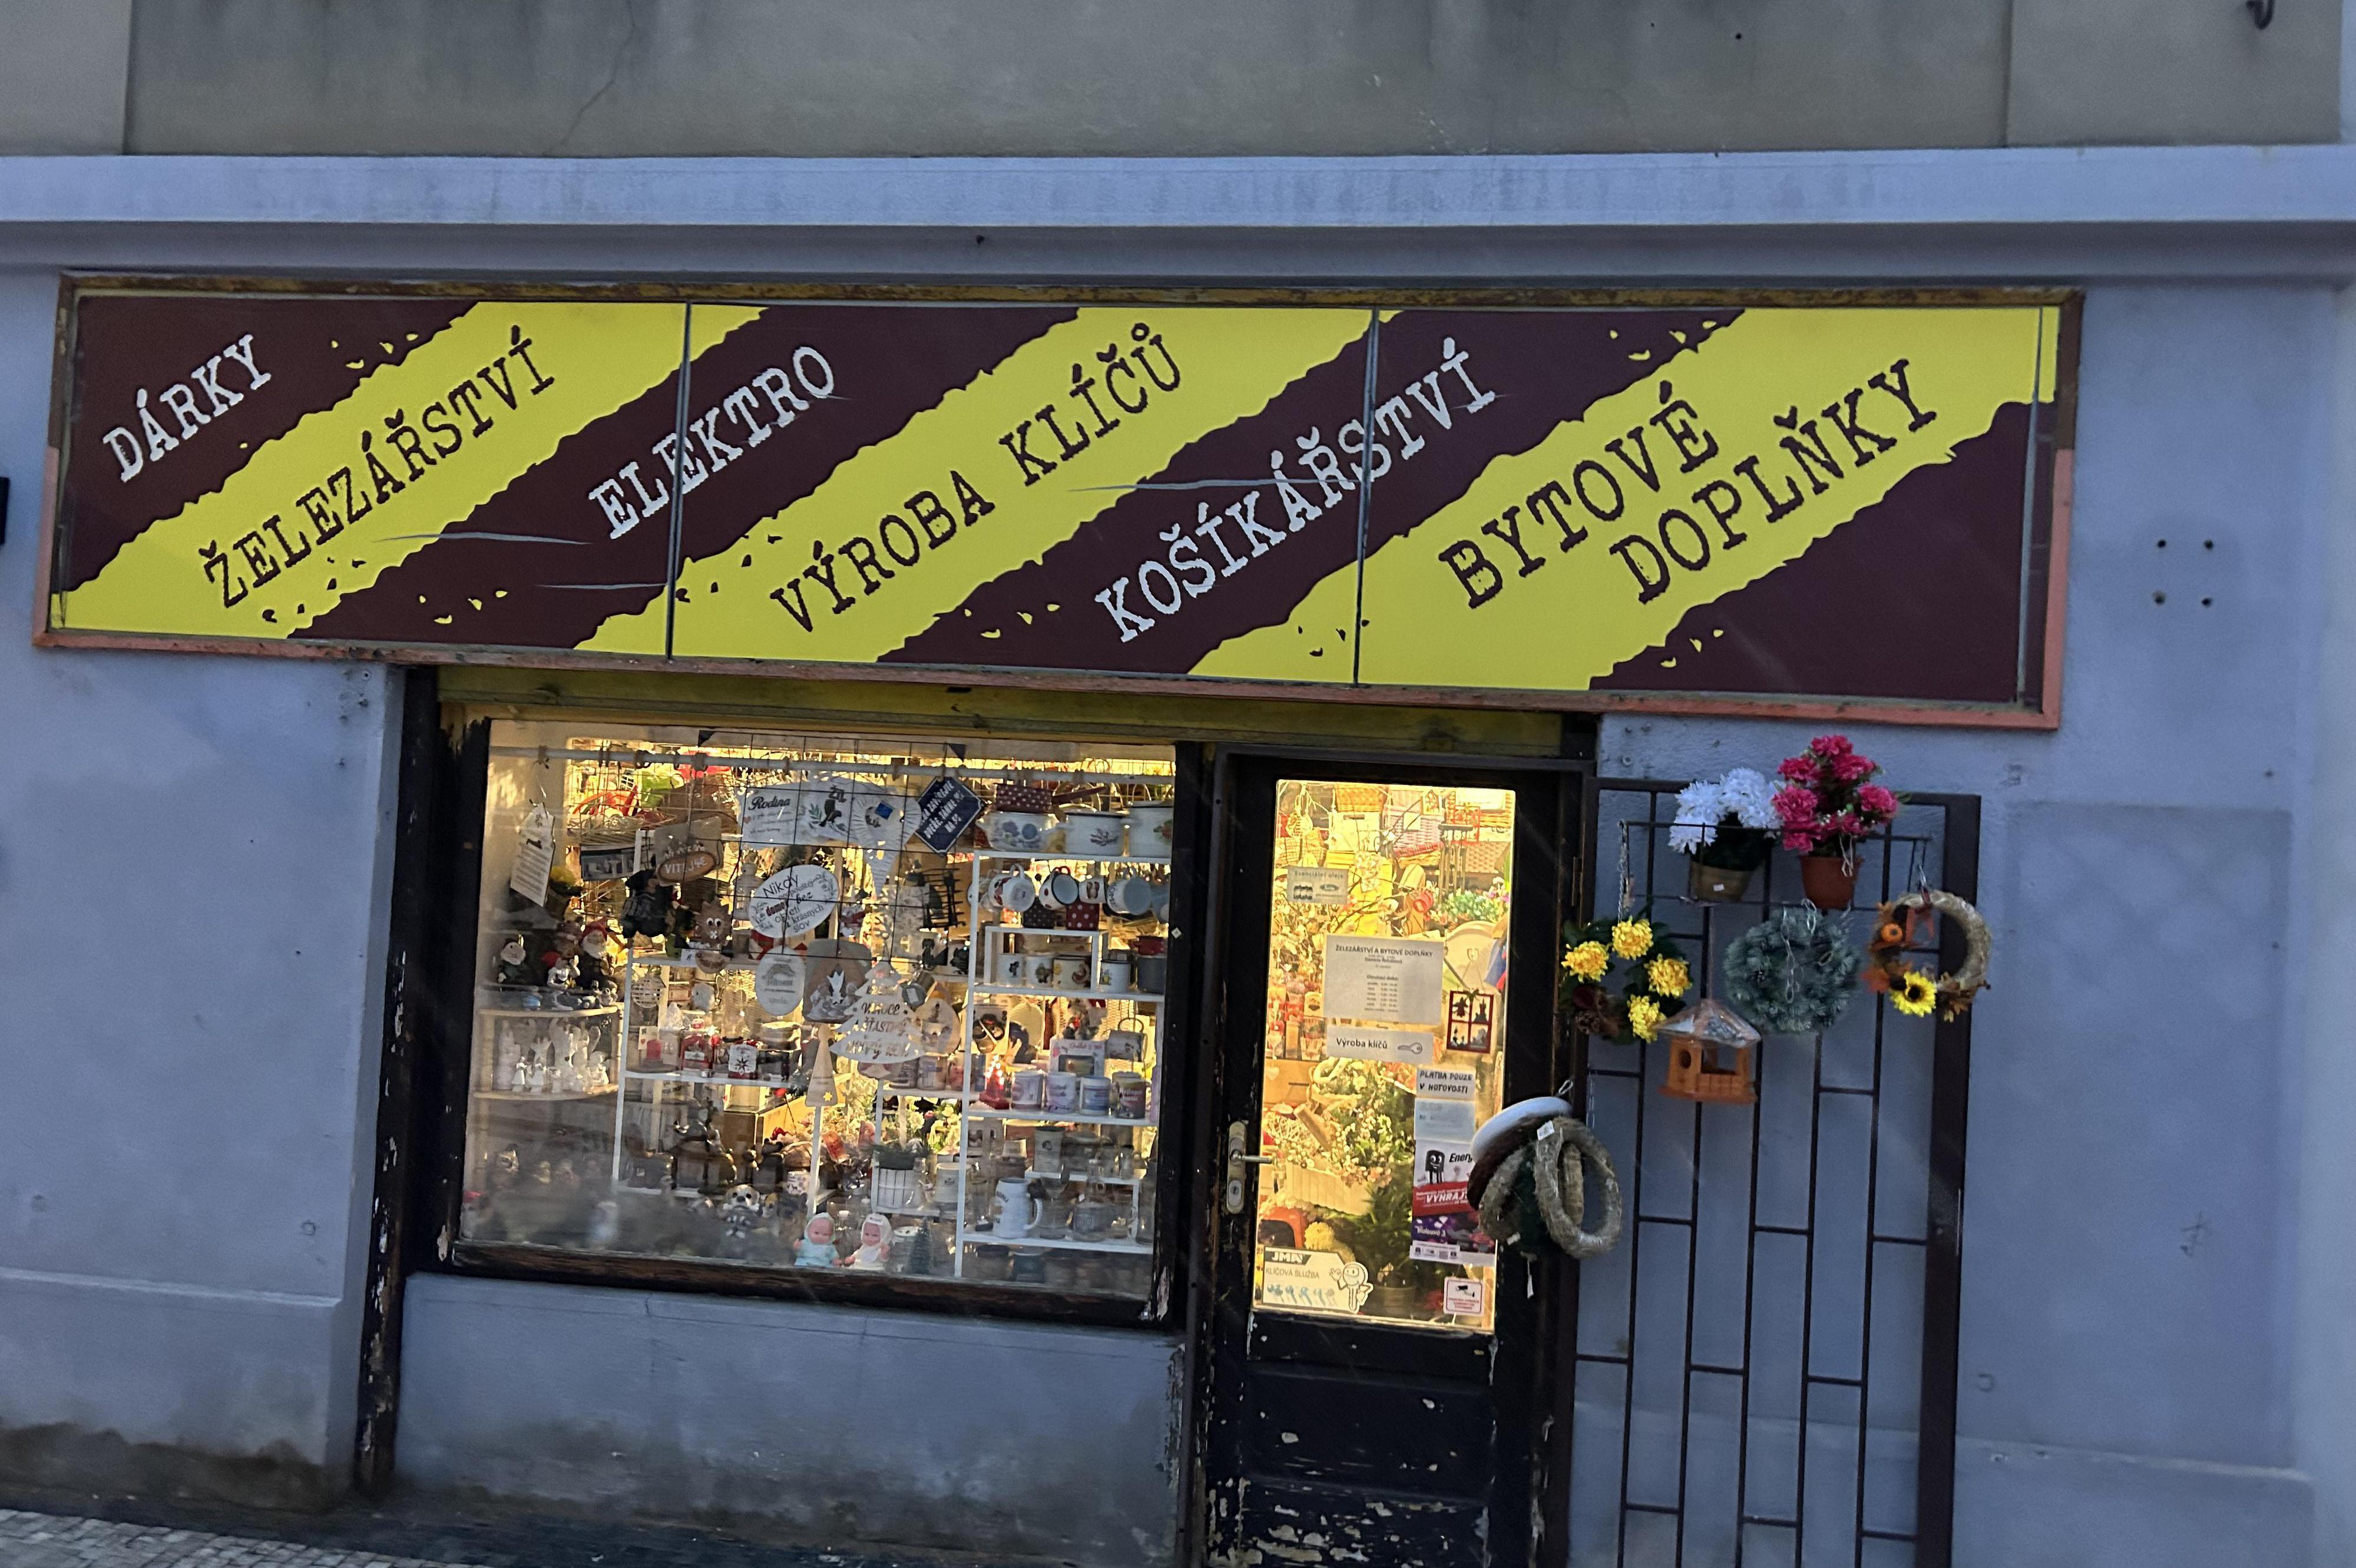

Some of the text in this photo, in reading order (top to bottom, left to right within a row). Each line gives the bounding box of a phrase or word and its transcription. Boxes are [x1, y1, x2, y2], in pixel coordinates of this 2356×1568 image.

[102, 334, 272, 482] DÁRKY
[588, 346, 834, 540] ELEKTRO
[198, 325, 555, 608] ŽELEZÁŘSTVÍ
[770, 322, 1181, 633] VÝROBA KLÍČŮ
[1094, 337, 1496, 643] KOŠÍKÁŘSTVÍ
[1609, 359, 1937, 605] DOPLŇKY
[1438, 379, 1719, 609] BYTOVÉ
[747, 796, 790, 811] Rodina
[762, 874, 799, 898] Nikdy
[791, 904, 824, 924] krásných
[793, 920, 810, 933] slov
[1335, 944, 1374, 953] ŽELEZÁŘSTVÍ
[1380, 947, 1403, 955] BYTOVÉ
[1336, 1037, 1388, 1049] Výroba klíčů
[1419, 1070, 1473, 1081] PLATBA POUZE
[1428, 1083, 1468, 1094] HOTOVOSTI
[1266, 1266, 1319, 1279] KLÍČOVÁ SLUŽBA
